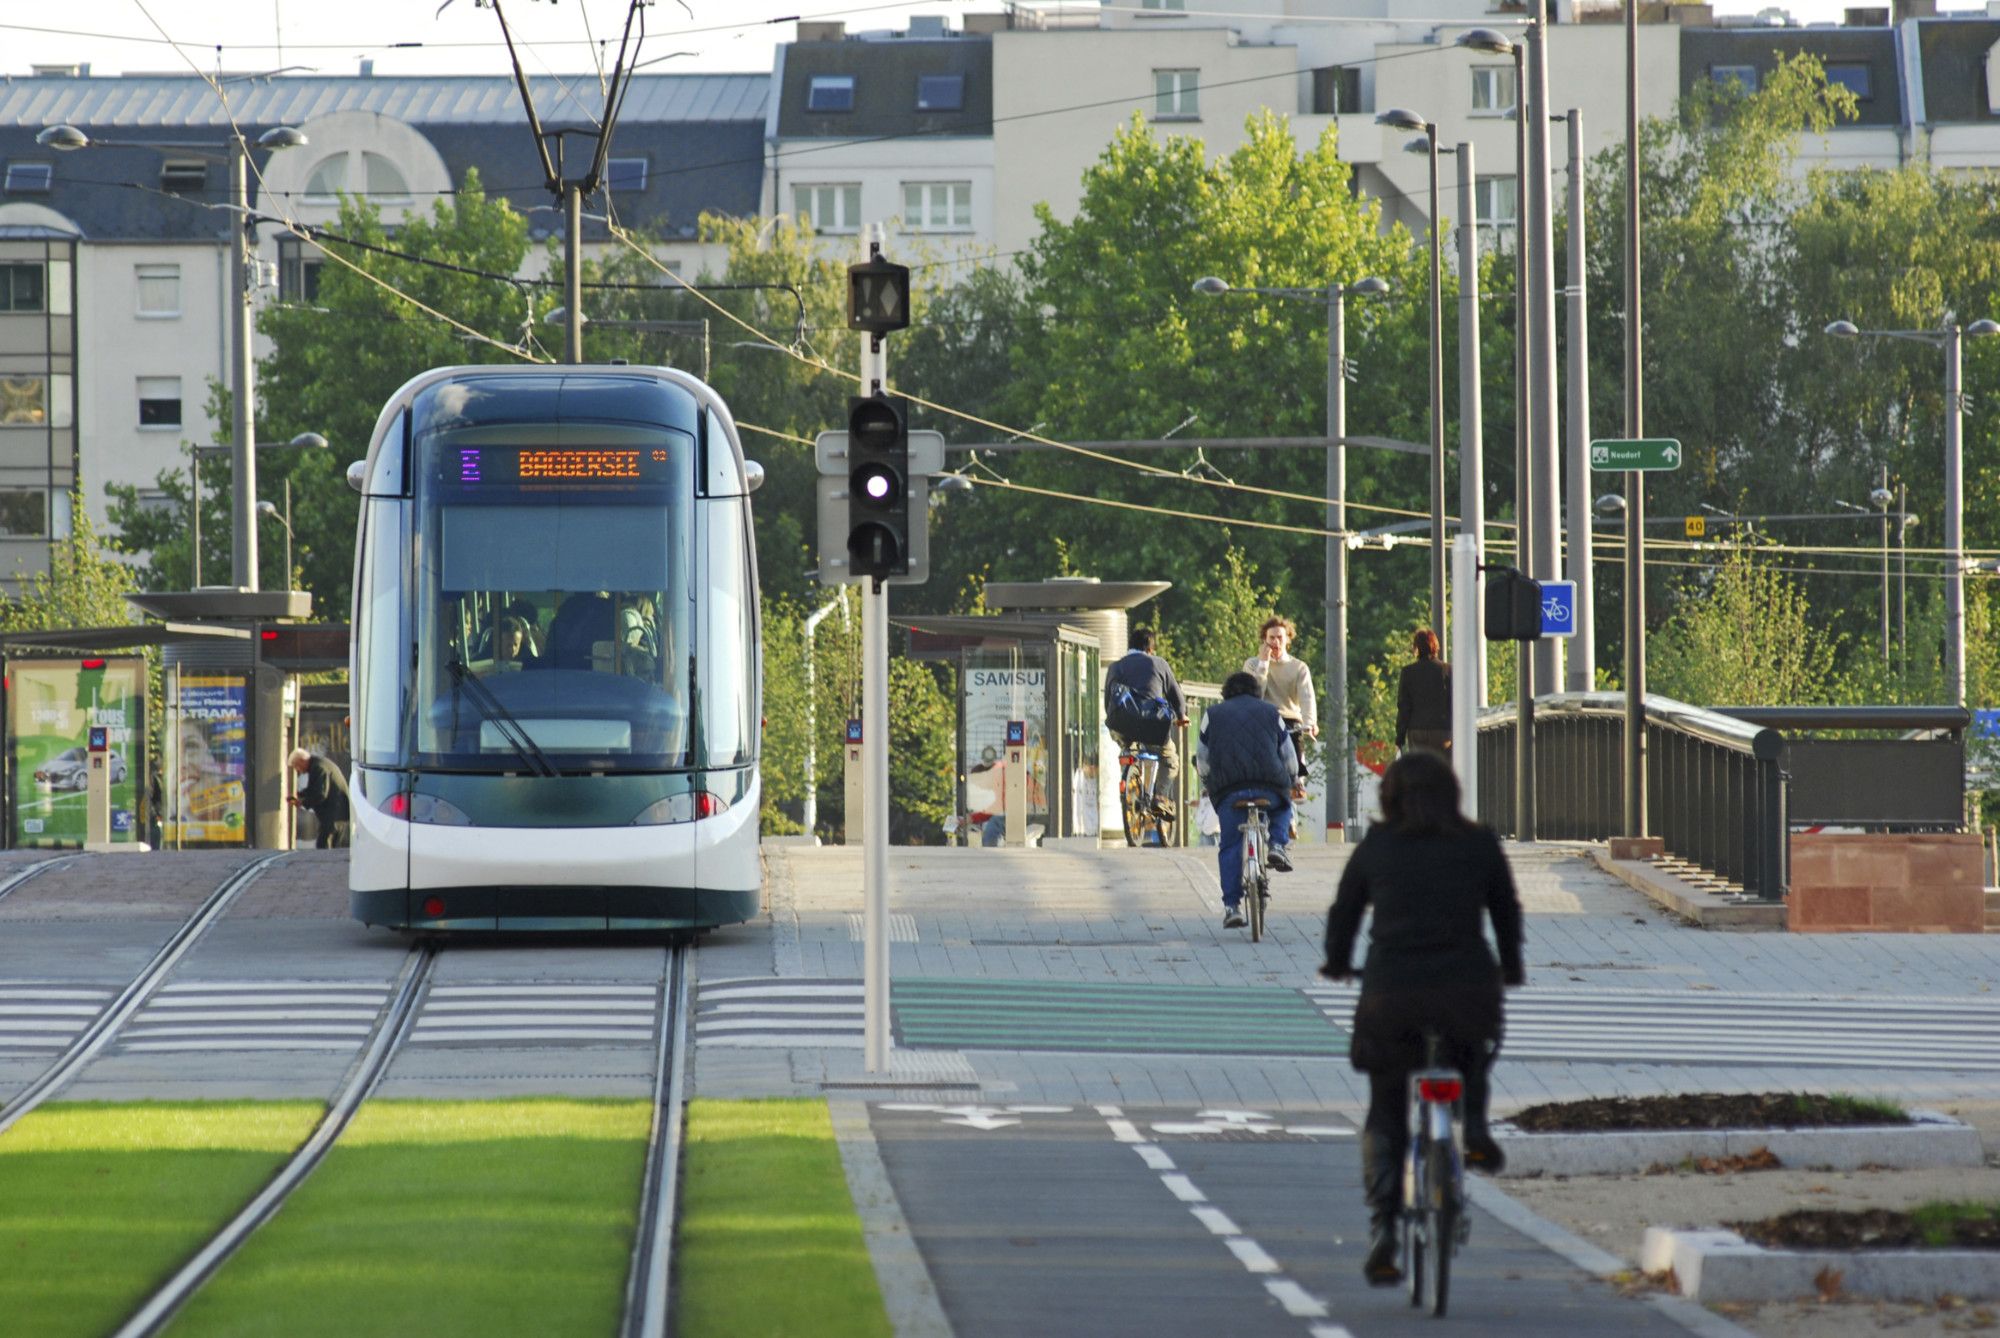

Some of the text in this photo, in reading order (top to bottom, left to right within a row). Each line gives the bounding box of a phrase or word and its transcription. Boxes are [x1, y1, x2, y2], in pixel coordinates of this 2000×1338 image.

[1611, 451, 1641, 459] Neudorf
[461, 449, 480, 481] E
[519, 450, 640, 478] BAGGERSEE
[1688, 521, 1703, 531] 40
